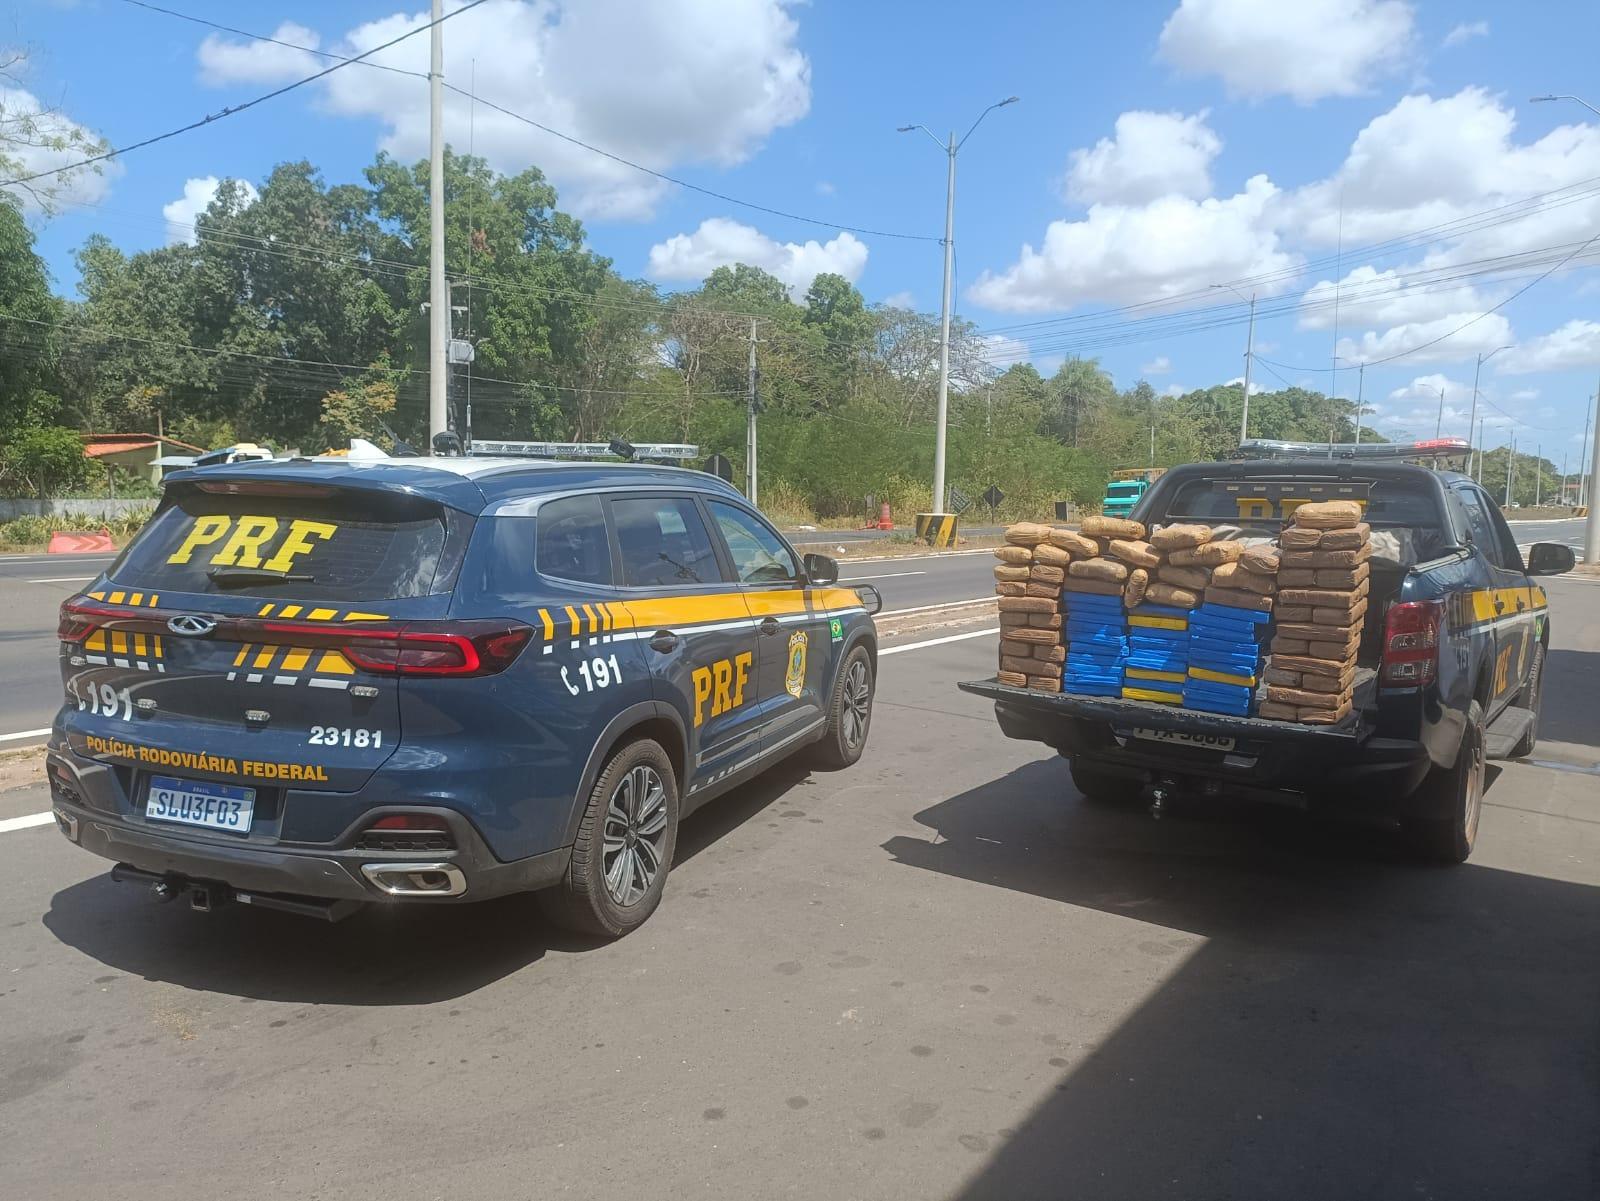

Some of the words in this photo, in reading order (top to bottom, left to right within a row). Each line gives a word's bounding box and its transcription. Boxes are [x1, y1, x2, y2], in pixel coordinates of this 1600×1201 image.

[166, 515, 338, 573] PRF
[579, 654, 622, 692] 191
[692, 651, 752, 728] PRF
[87, 681, 133, 721] 191
[308, 726, 382, 749] 23181
[86, 736, 136, 759] POLÍCIA
[139, 746, 238, 774] RODOVIÁRIA
[243, 760, 328, 781] FEDERAL
[156, 791, 242, 826] SLU3F03
